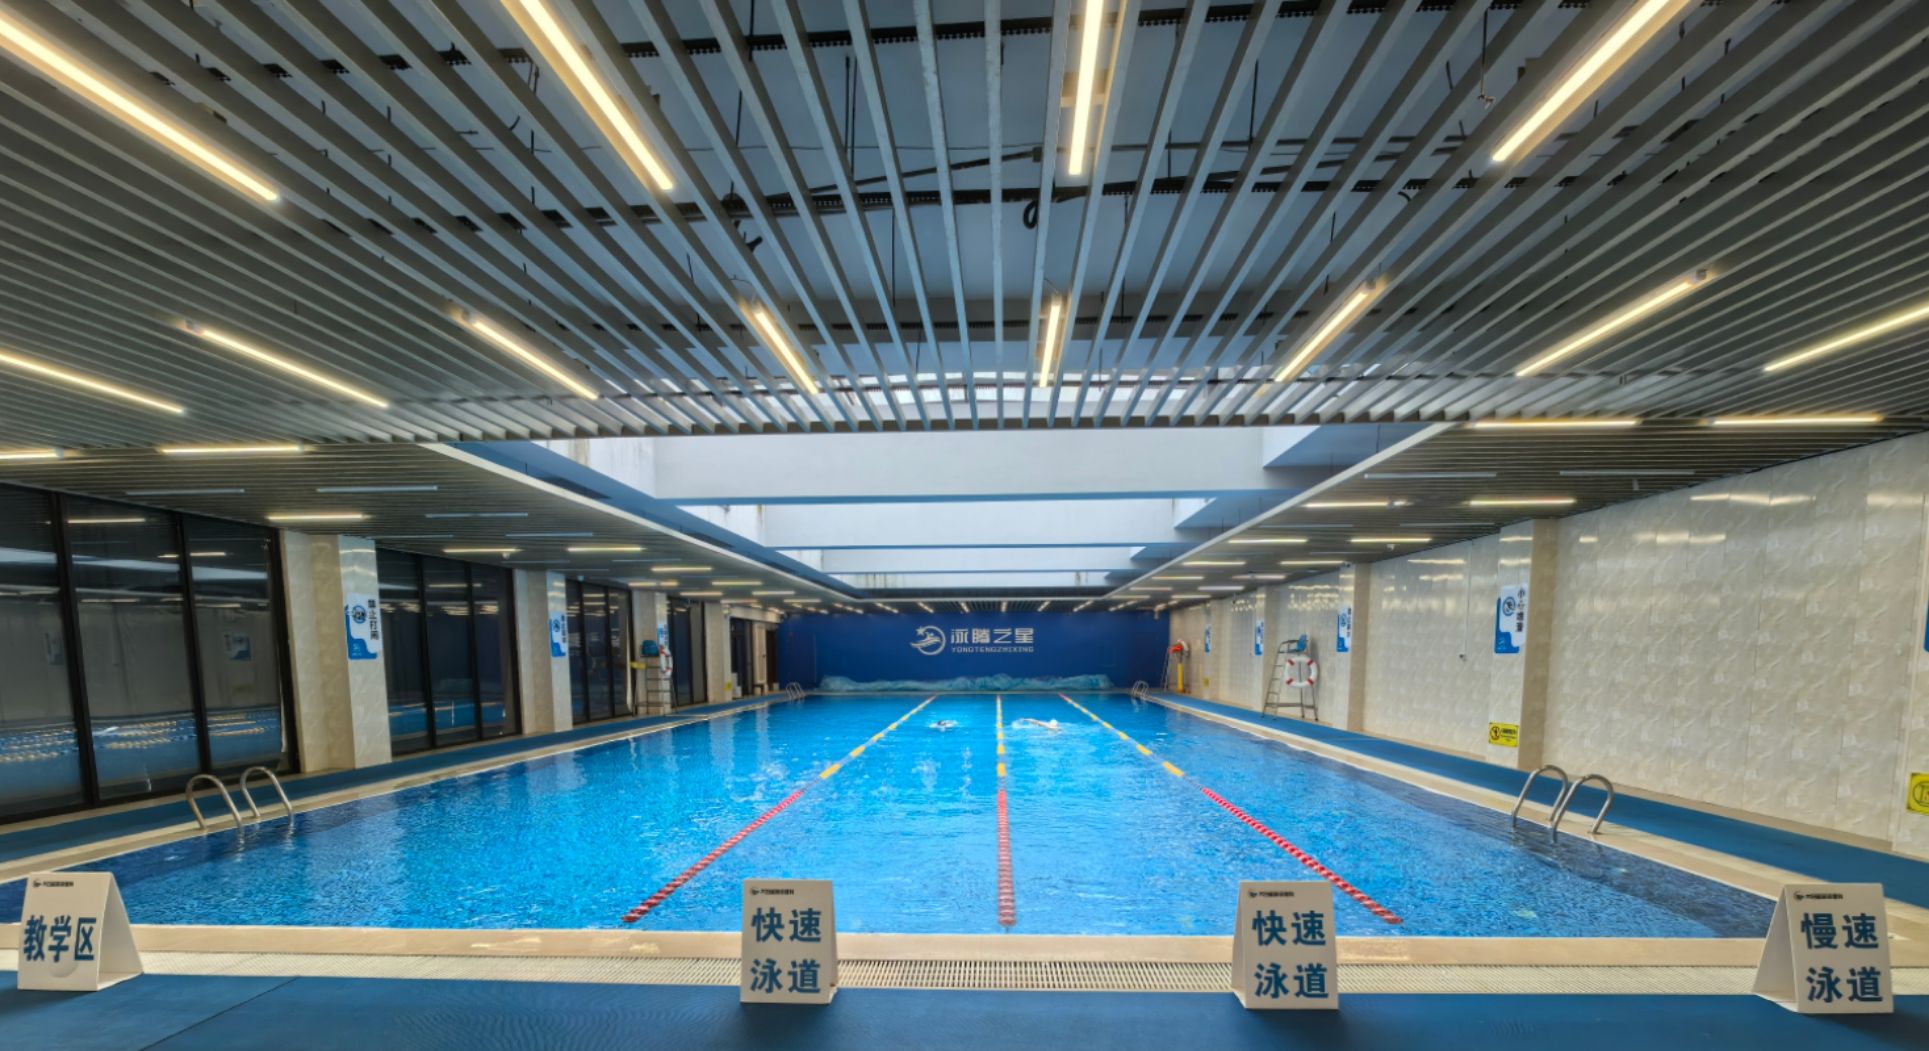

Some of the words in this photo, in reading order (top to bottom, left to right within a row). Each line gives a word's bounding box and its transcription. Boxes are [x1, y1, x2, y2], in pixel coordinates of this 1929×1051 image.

[951, 628, 1034, 644] 泳腾之星
[23, 914, 97, 963] 教学区
[751, 906, 821, 943] 快速
[1252, 909, 1326, 946] 快速
[1801, 912, 1879, 949] 慢速
[750, 957, 821, 993] 泳道
[1254, 962, 1328, 999] 泳道
[1806, 966, 1883, 1003] 泳道
